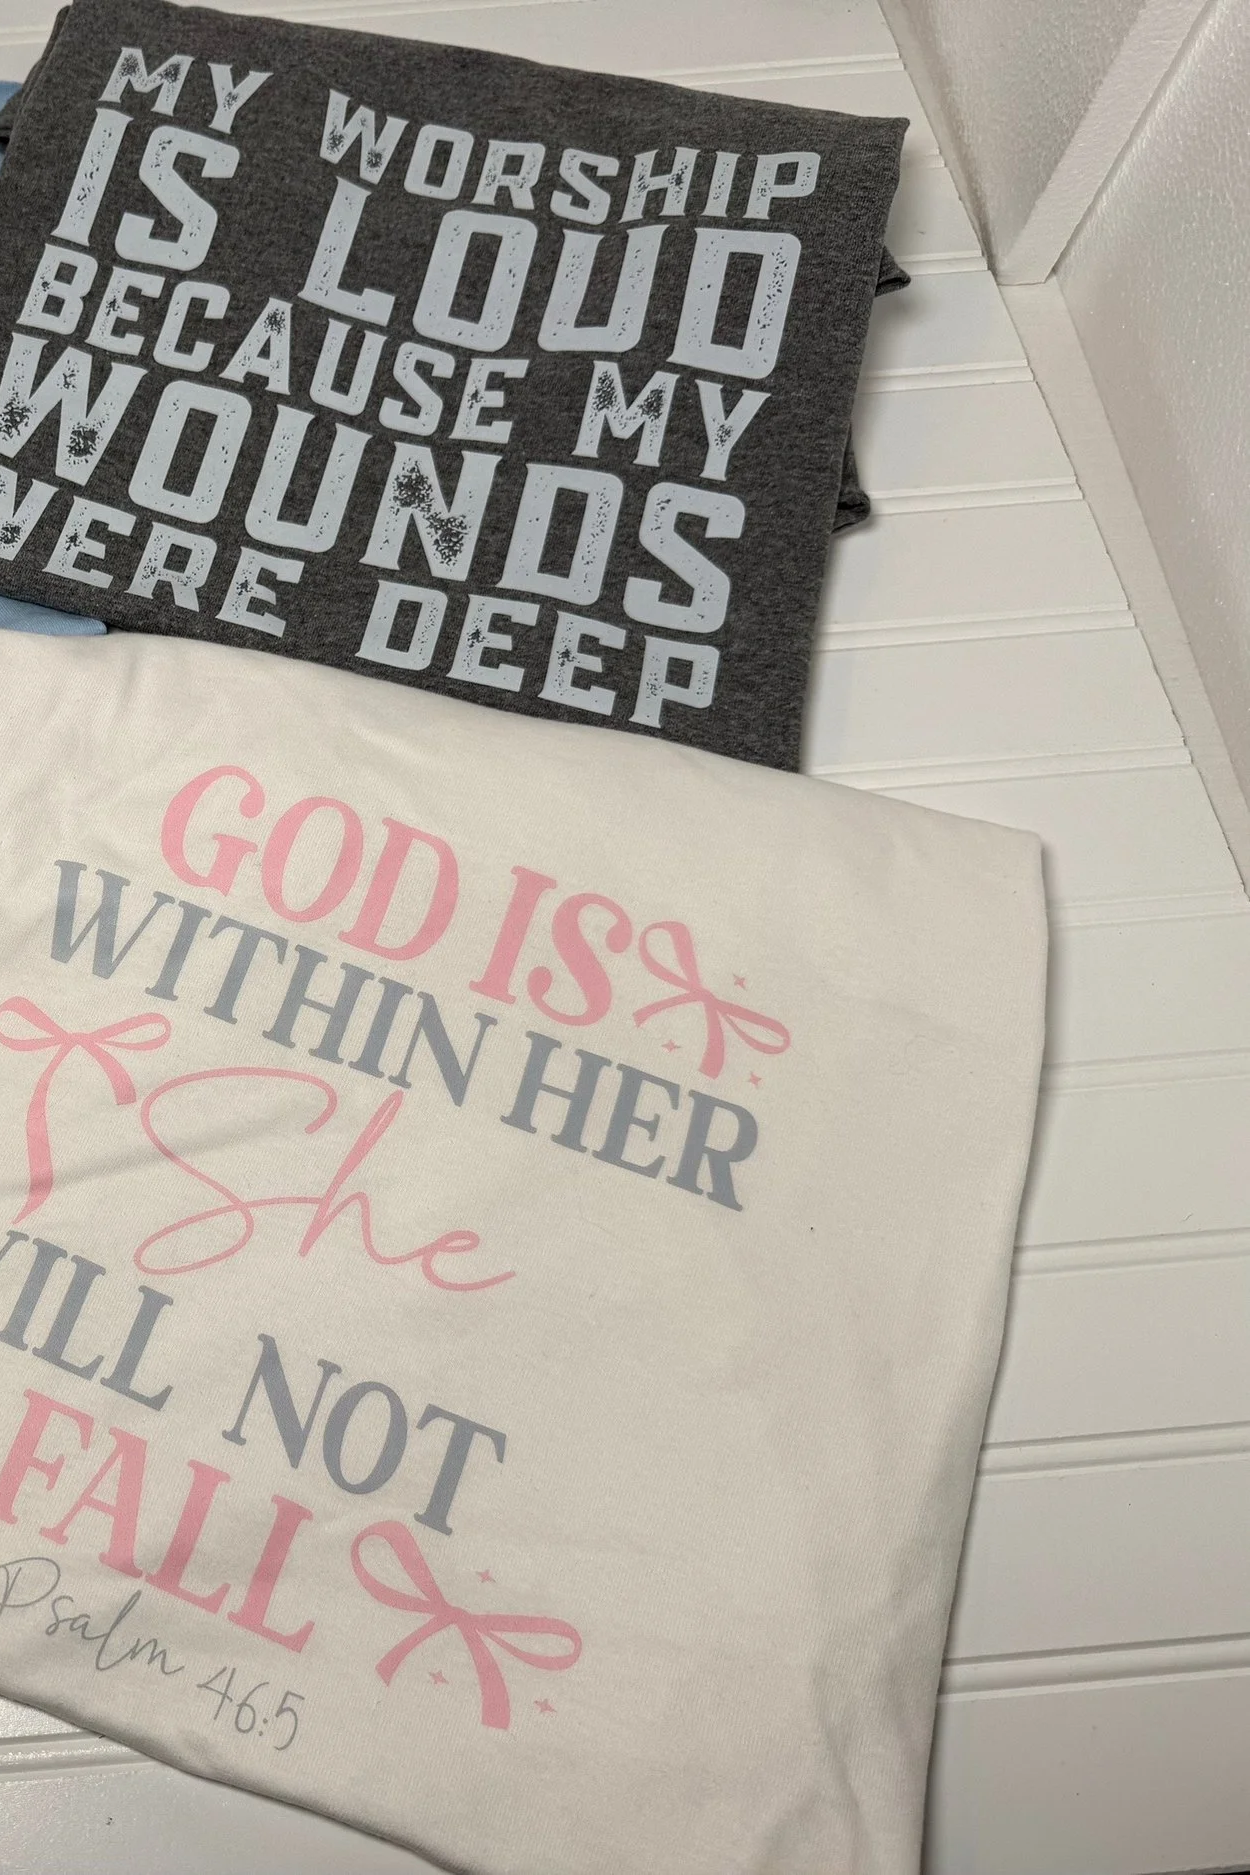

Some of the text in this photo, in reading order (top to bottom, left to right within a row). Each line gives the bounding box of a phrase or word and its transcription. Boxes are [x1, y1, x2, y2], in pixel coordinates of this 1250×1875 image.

[50, 107, 801, 380] IS LOUD
[98, 46, 821, 226] MY WORSHIP
[17, 243, 771, 481] BECAUSE MY
[355, 580, 720, 729] DEEP
[159, 765, 634, 1027] GOD IS
[50, 859, 759, 1211] WITHIN HER
[133, 1066, 517, 1292] She
[221, 1333, 507, 1536] NOT
[196, 1666, 304, 1751] 46:5
